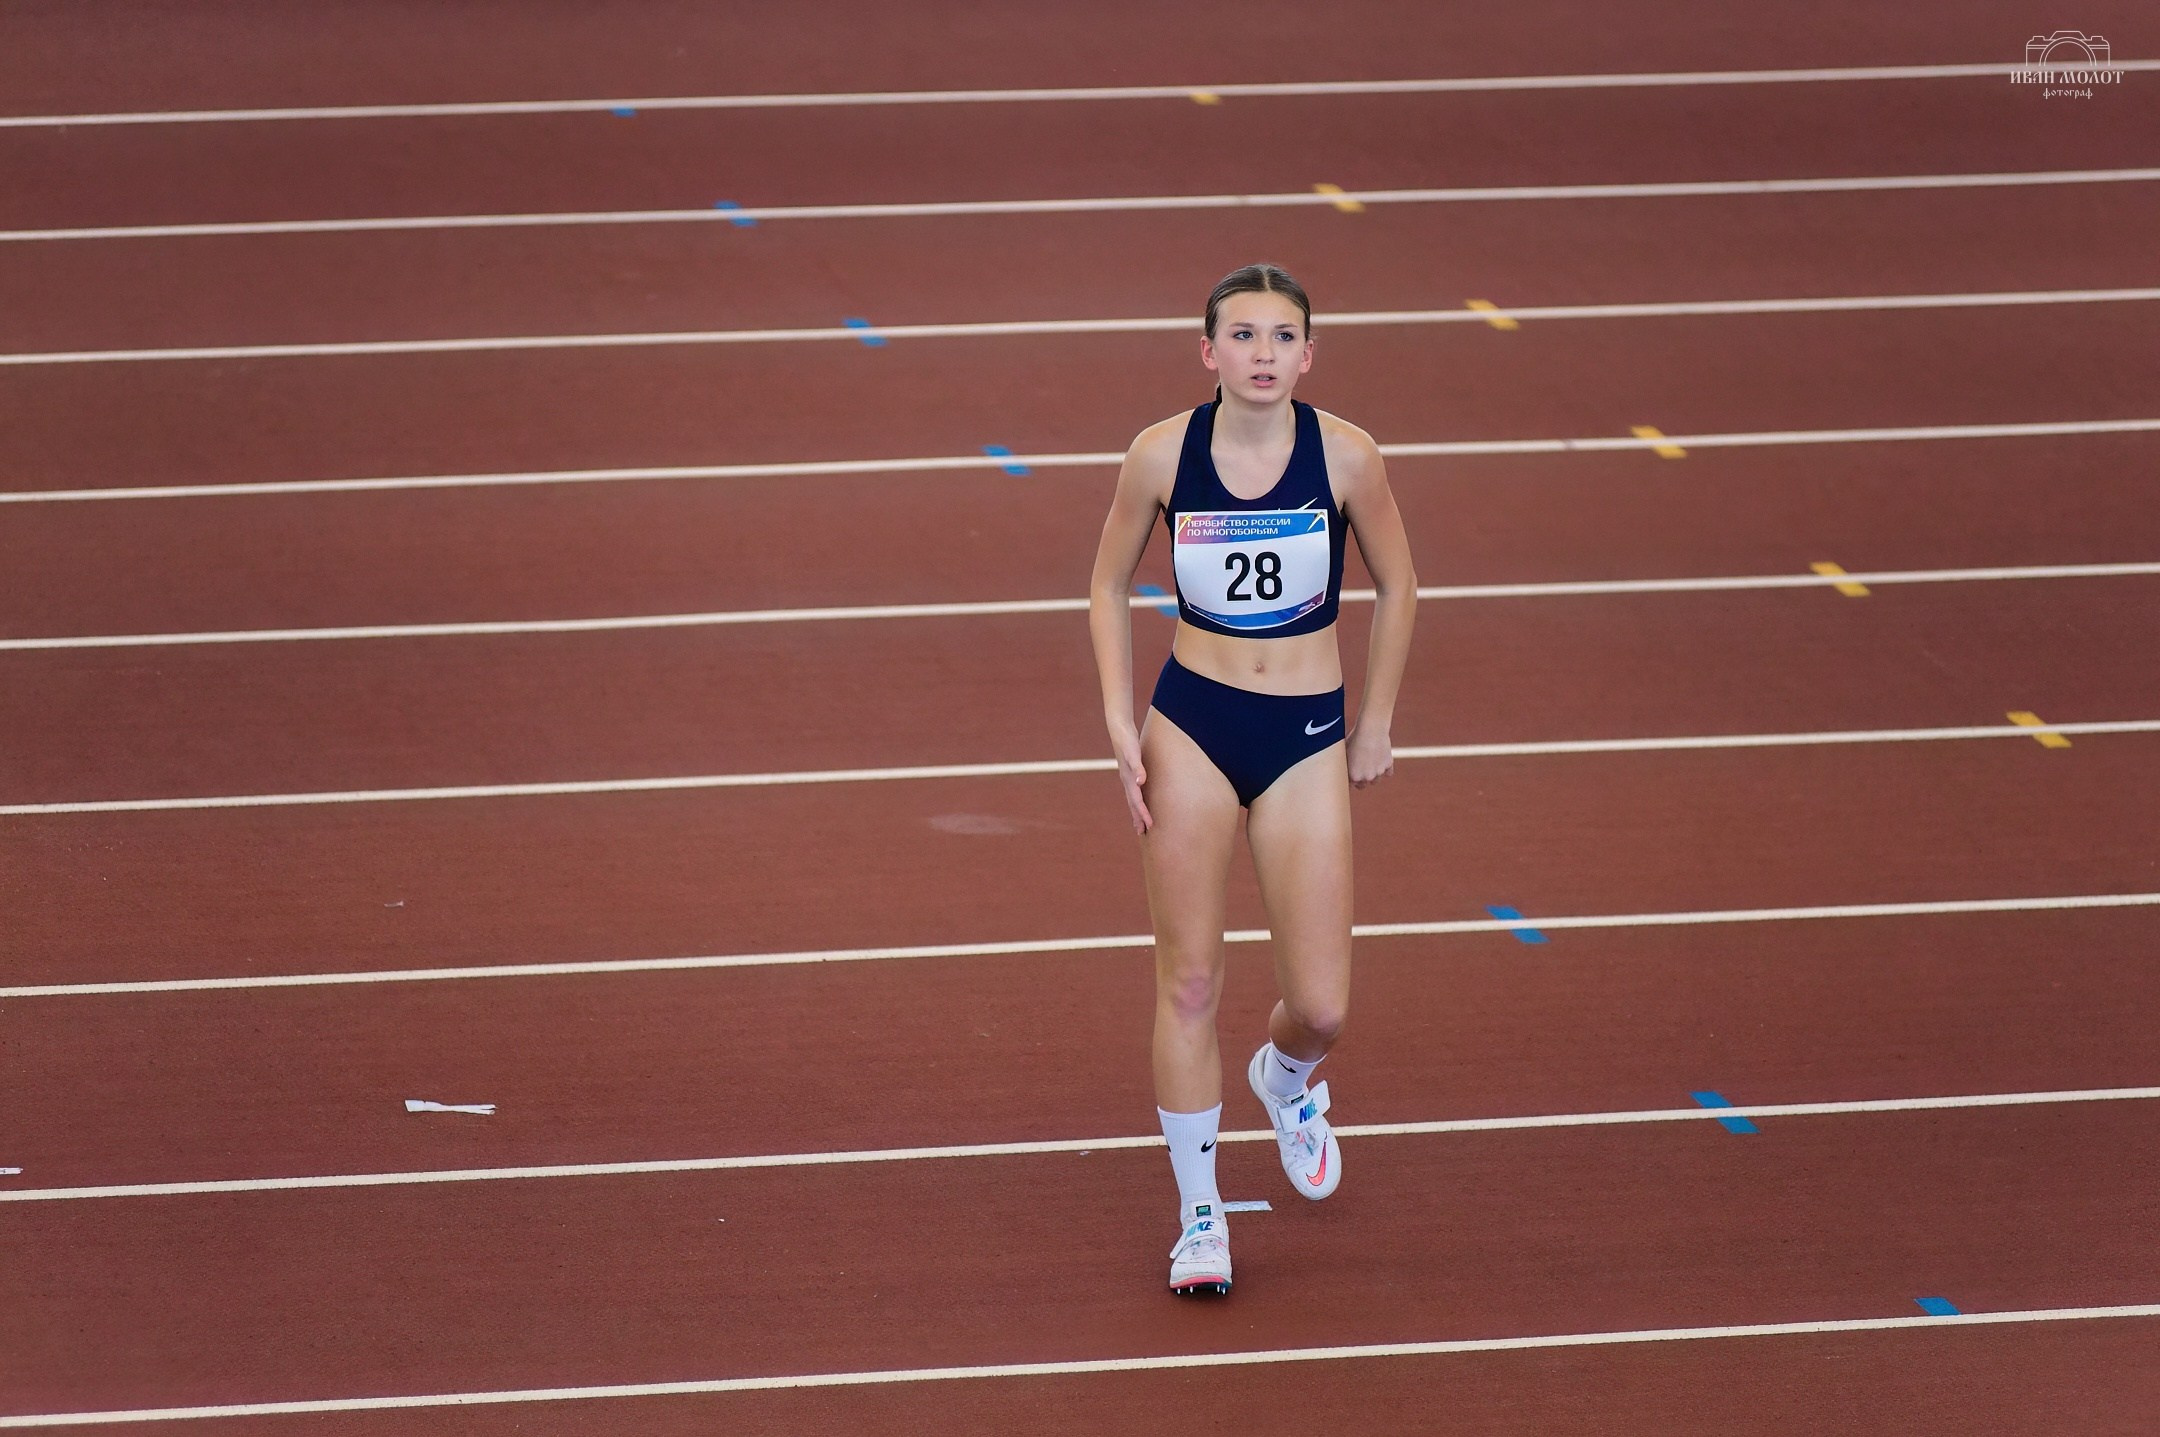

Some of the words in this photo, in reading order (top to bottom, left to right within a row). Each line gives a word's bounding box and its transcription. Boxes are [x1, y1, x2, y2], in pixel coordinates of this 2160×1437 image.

[1187, 518, 1249, 528] ПЕРВЕНСТВО
[1251, 518, 1291, 526] РОССИИ
[1187, 528, 1201, 537] ПО
[1203, 527, 1279, 537] МНОГОБОРЬЯМ
[1225, 551, 1283, 602] 28
